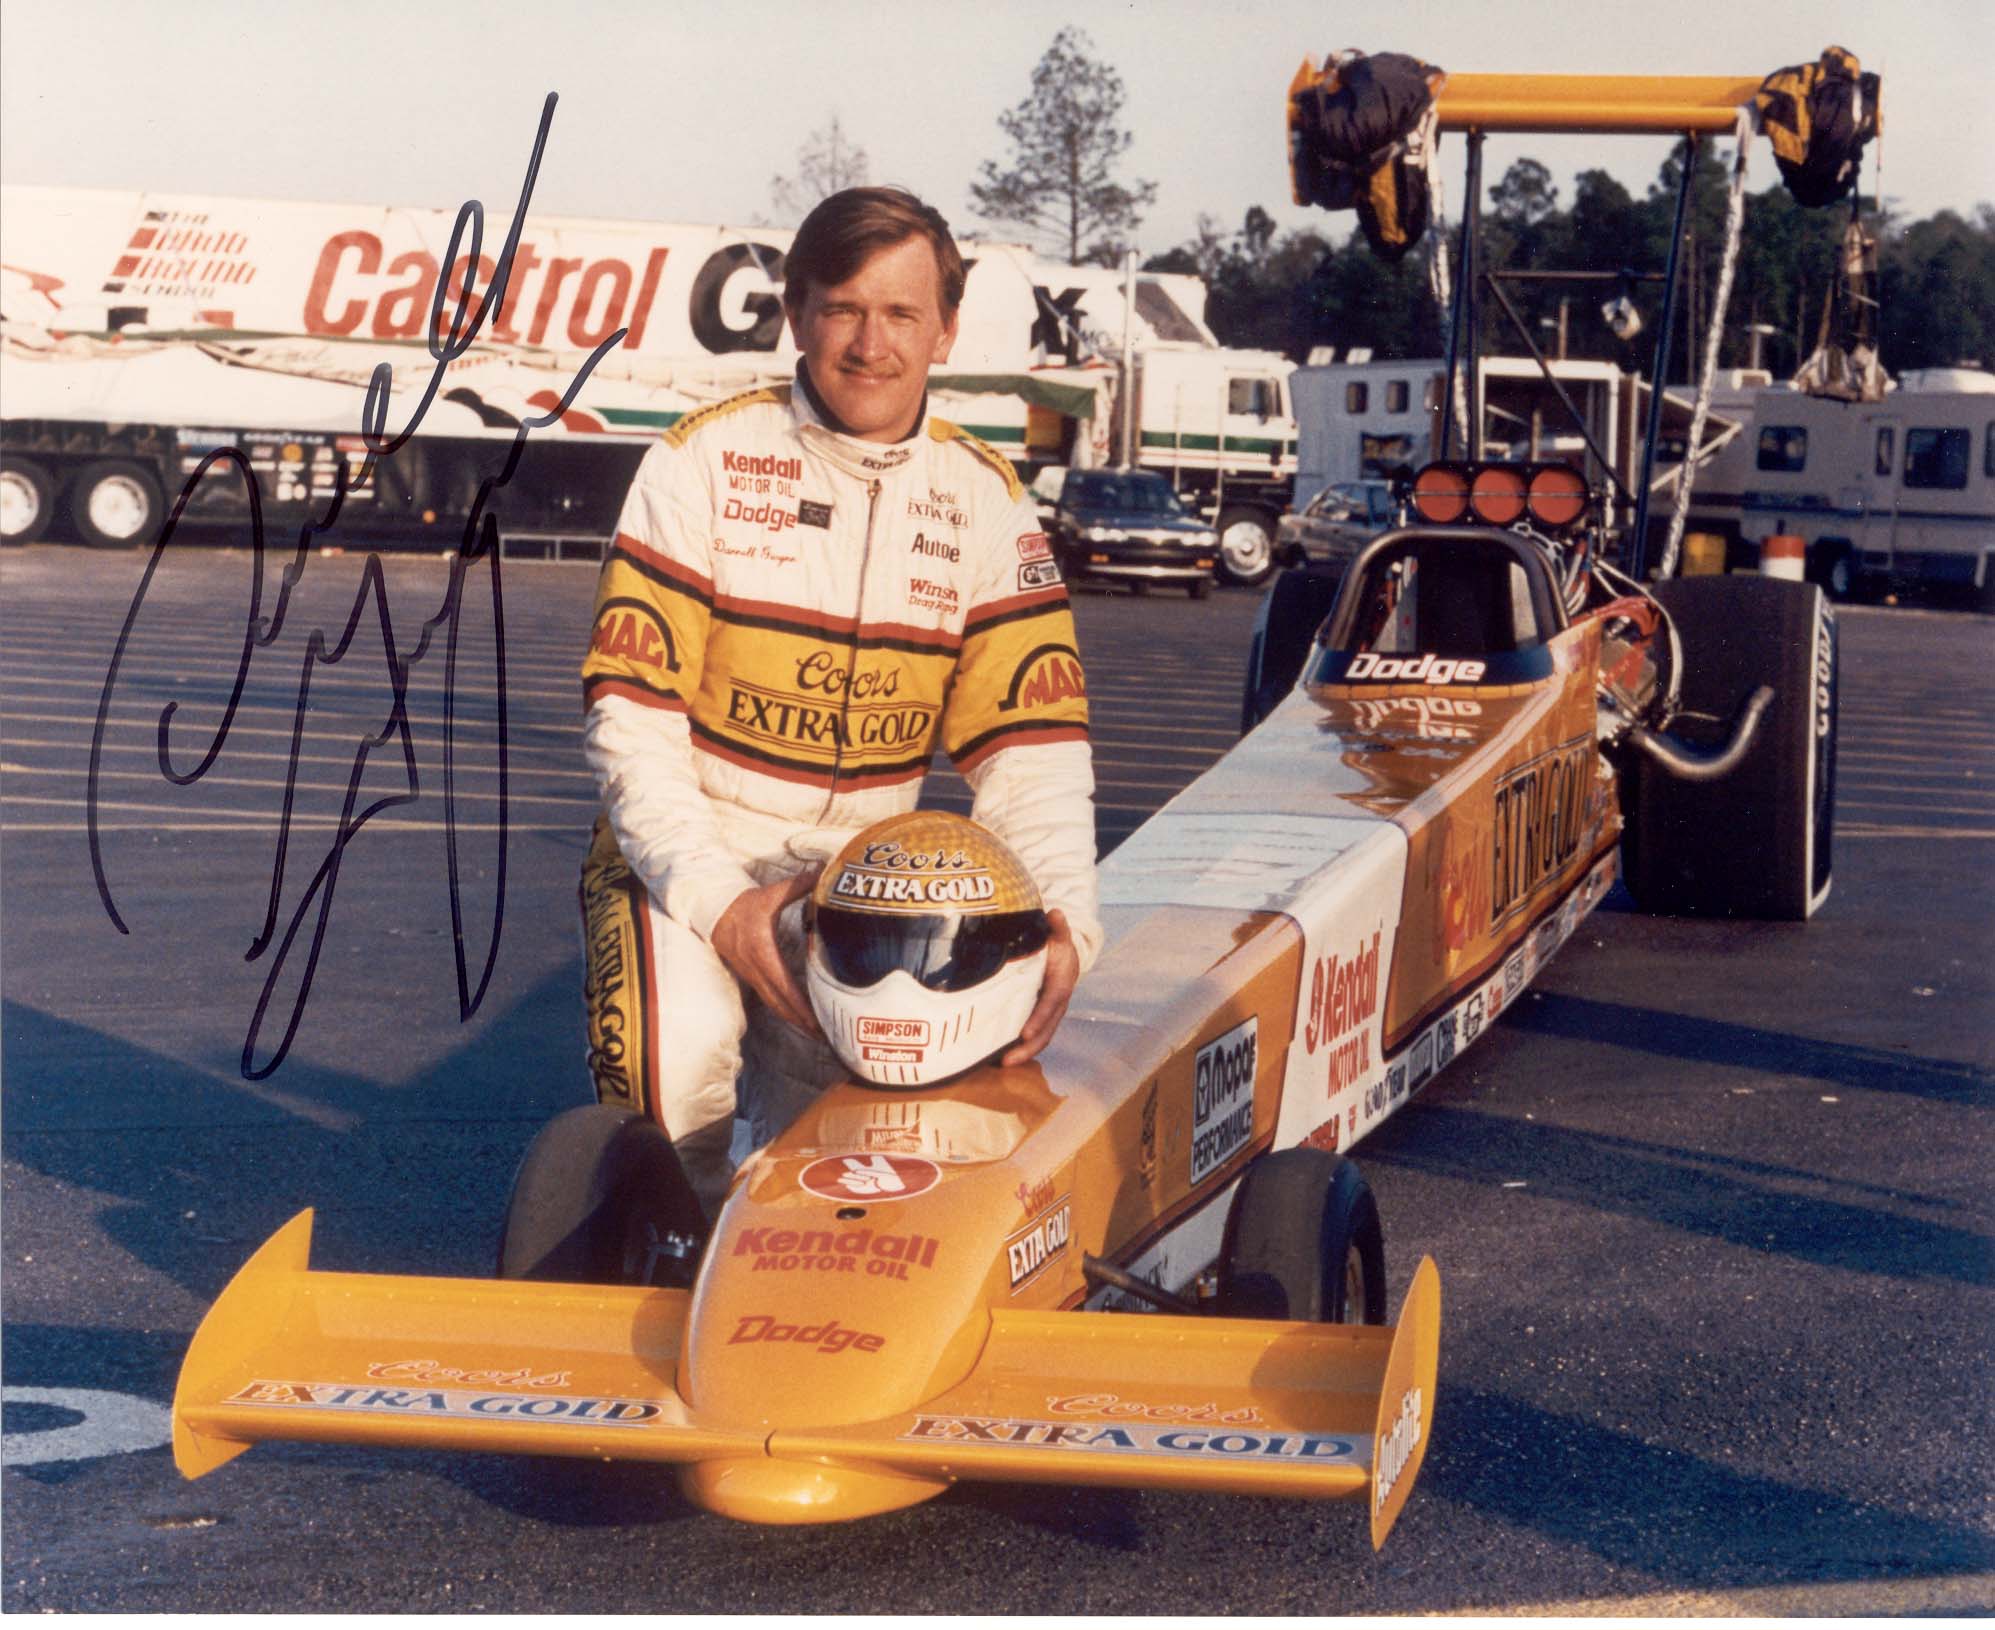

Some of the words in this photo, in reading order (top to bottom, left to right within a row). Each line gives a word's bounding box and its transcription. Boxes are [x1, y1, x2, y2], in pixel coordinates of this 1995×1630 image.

[303, 230, 669, 350] Castrol
[722, 451, 802, 480] Kendall
[729, 475, 771, 493] MOTOR
[777, 480, 795, 498] OIL
[724, 499, 798, 531] Dodge
[796, 651, 900, 698] Coors
[1345, 653, 1486, 684] Dodge
[727, 688, 853, 747] EXTRA
[860, 711, 930, 746] GOLD
[863, 842, 968, 868] Coors
[836, 871, 923, 901] EXTRA
[928, 875, 995, 901] GOLD
[1323, 931, 1380, 1046] Kendall
[863, 1021, 922, 1037] SIMPSON
[1211, 1038, 1256, 1108] Mopar
[1192, 1101, 1253, 1176] PERFORMANCE
[732, 1227, 940, 1269] Kendall
[1046, 1206, 1071, 1254] GOLD
[752, 1255, 856, 1272] MOTOR
[866, 1259, 909, 1280] OIL
[727, 1315, 886, 1354] Dodge
[368, 1360, 573, 1388] Coors
[232, 1383, 449, 1411] EXTRA
[468, 1396, 662, 1422] GOLD
[1047, 1394, 1260, 1423] Coors
[908, 1416, 1136, 1447] EXTRA
[1154, 1432, 1355, 1458] GOLD
